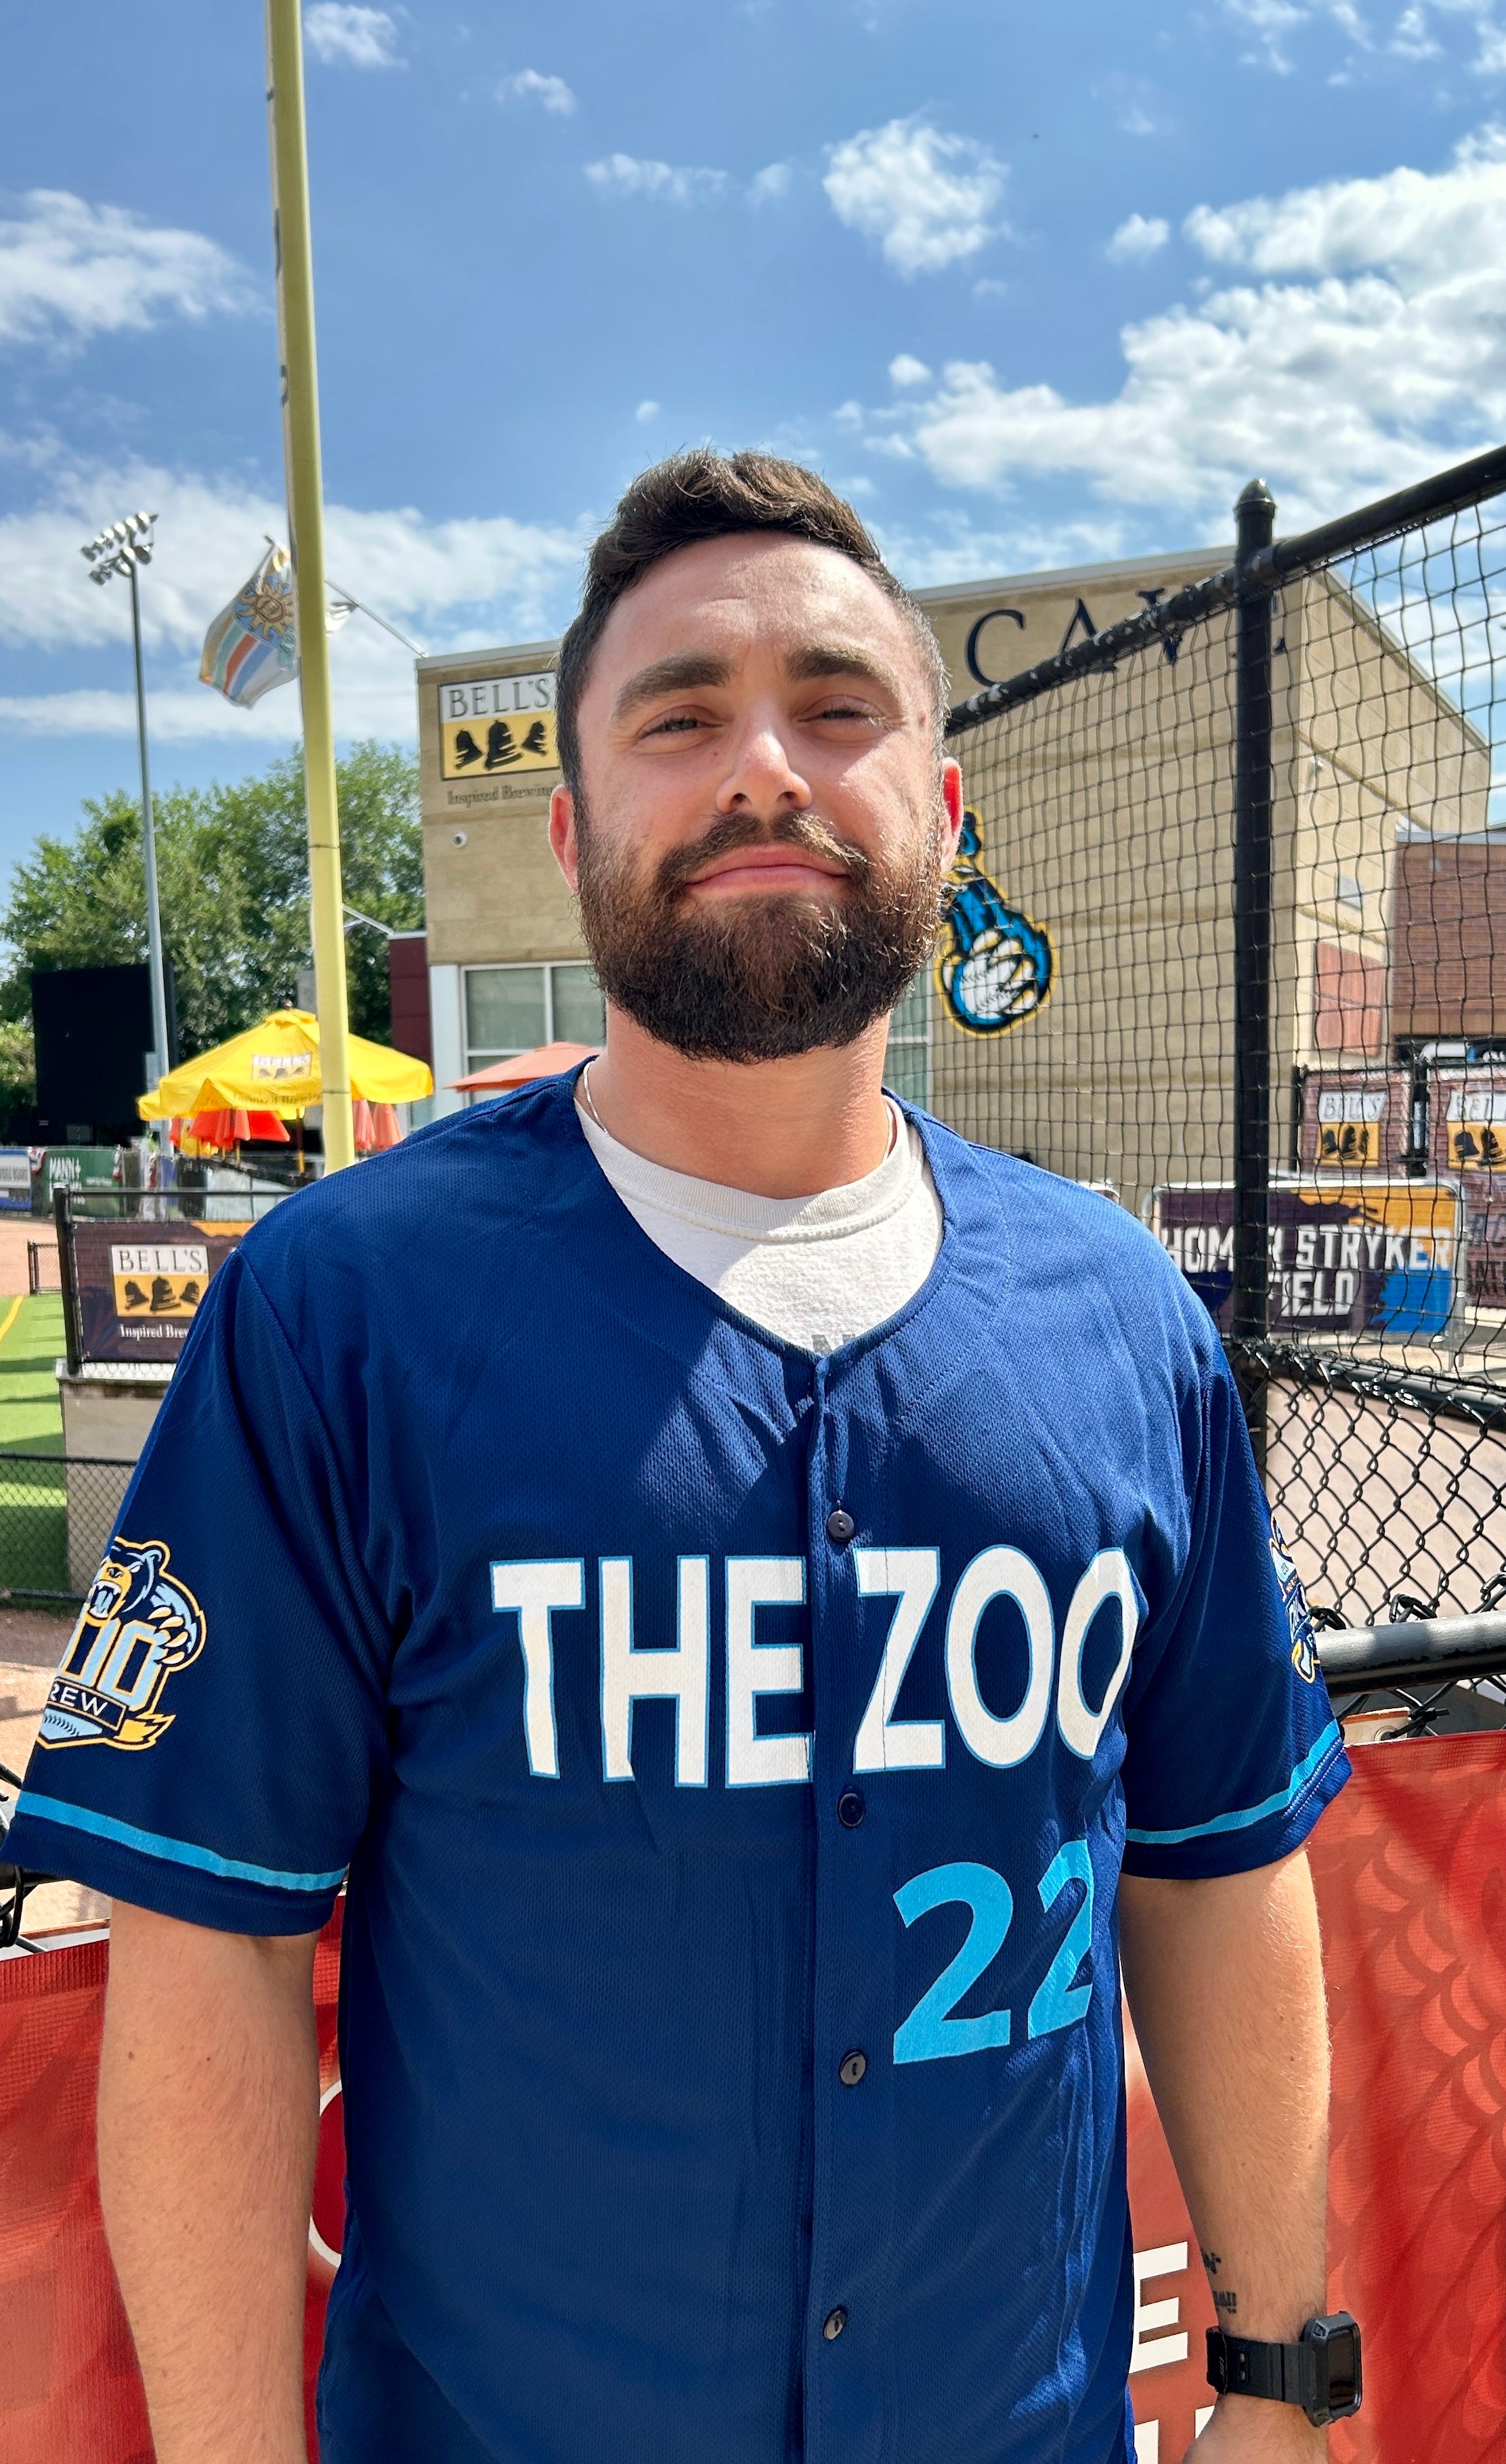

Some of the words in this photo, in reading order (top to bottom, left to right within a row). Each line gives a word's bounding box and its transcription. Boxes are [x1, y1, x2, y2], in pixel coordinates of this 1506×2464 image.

[448, 678, 551, 718] BELL'S
[119, 1250, 202, 1272] BELL'S
[1296, 1223, 1452, 1270] STRYKER
[120, 1324, 163, 1341] Inspired
[489, 1555, 813, 1789] THE
[851, 1544, 1139, 1775] ZOO
[892, 1838, 1094, 2065] 22
